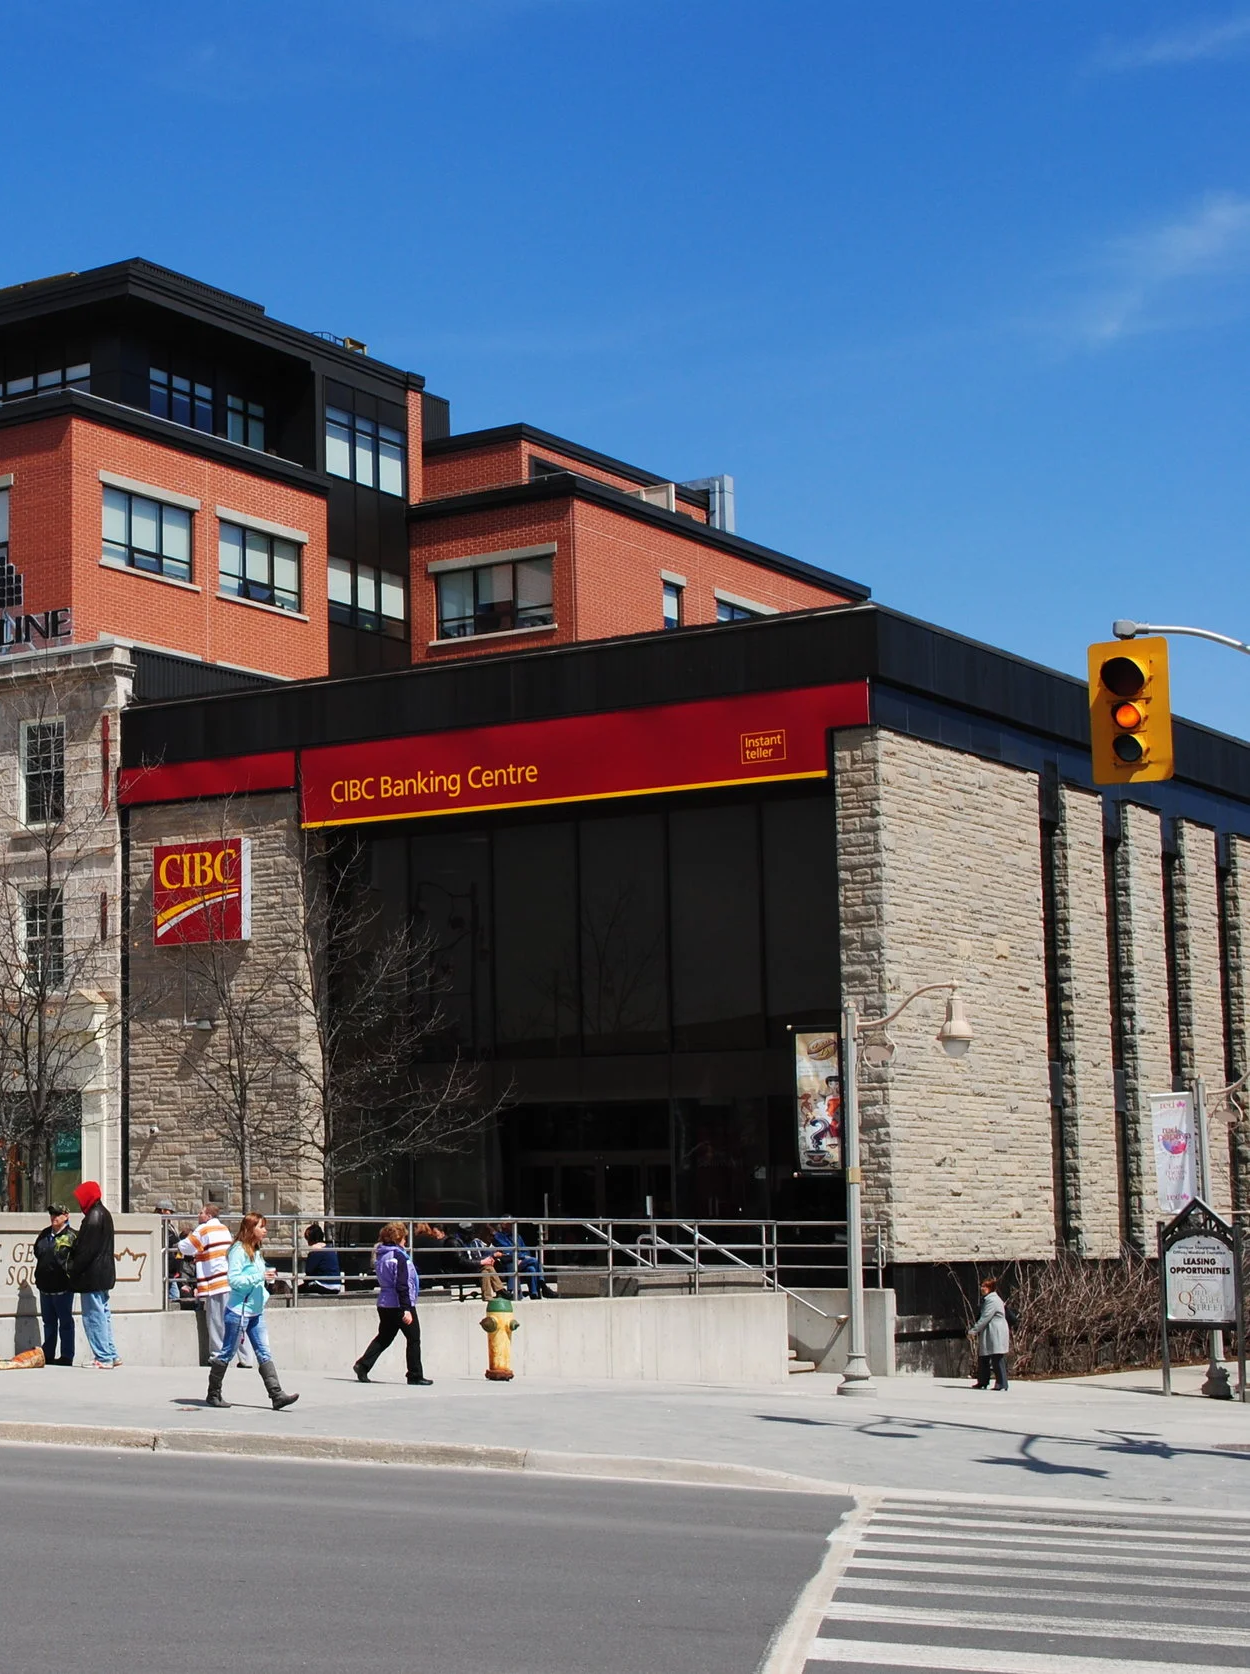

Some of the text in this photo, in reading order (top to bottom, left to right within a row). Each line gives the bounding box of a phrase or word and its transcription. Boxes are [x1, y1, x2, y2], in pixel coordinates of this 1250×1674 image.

[745, 734, 782, 748] Instant
[745, 747, 773, 760] teller
[330, 763, 538, 803] CIBC Banking Centre
[159, 848, 237, 890] CIBC
[1183, 1257, 1216, 1266] LEASING
[1169, 1266, 1231, 1275] OPPORTUNITIES
